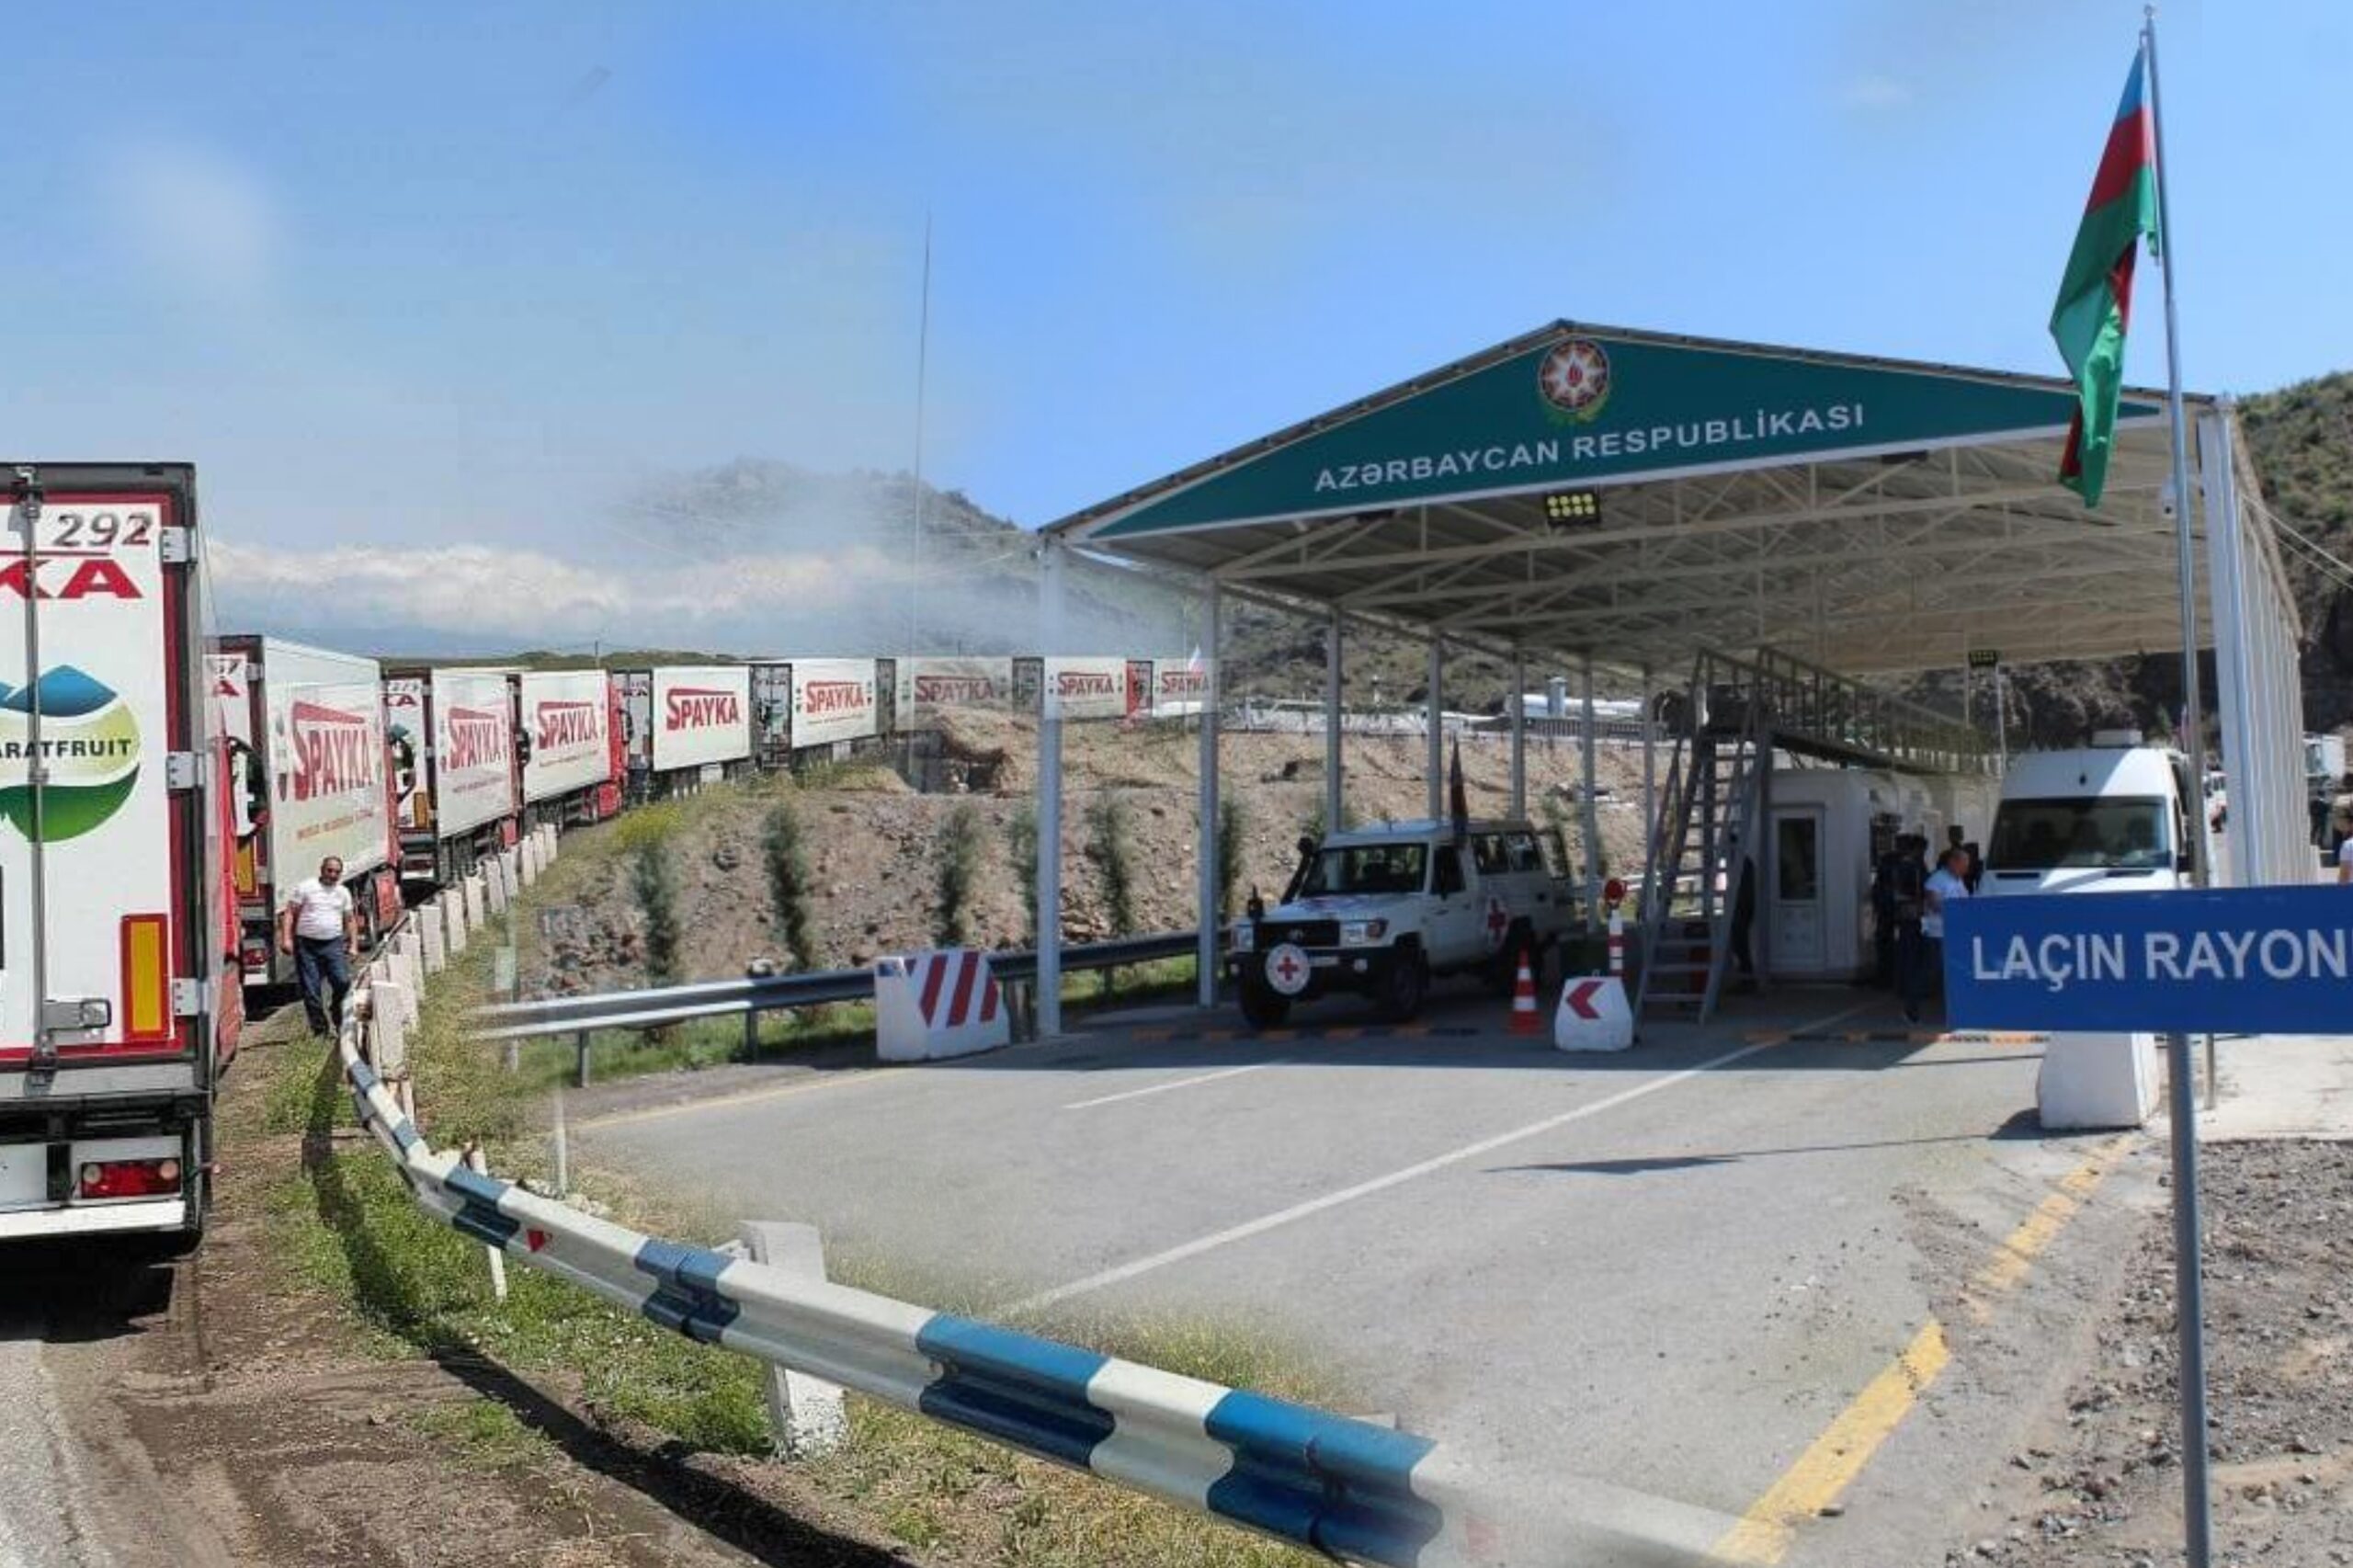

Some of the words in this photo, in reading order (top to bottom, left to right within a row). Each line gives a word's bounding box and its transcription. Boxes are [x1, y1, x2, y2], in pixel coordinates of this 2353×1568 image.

[1314, 439, 1560, 493] AZƏRBAYCAN
[1574, 403, 1865, 460] RESPUBLİKASI
[53, 513, 153, 547] 292
[806, 681, 864, 713] SPAYKA
[915, 676, 995, 702] SPAYKA
[1057, 672, 1114, 697] SPAYKA
[537, 701, 597, 750] SPAYKA
[666, 688, 739, 731] SPAYKA
[0, 739, 131, 759] RATFRUIT
[291, 701, 372, 801] SPAYKA
[448, 707, 502, 770] SPAYKA
[1972, 932, 2126, 993] LAÇIN
